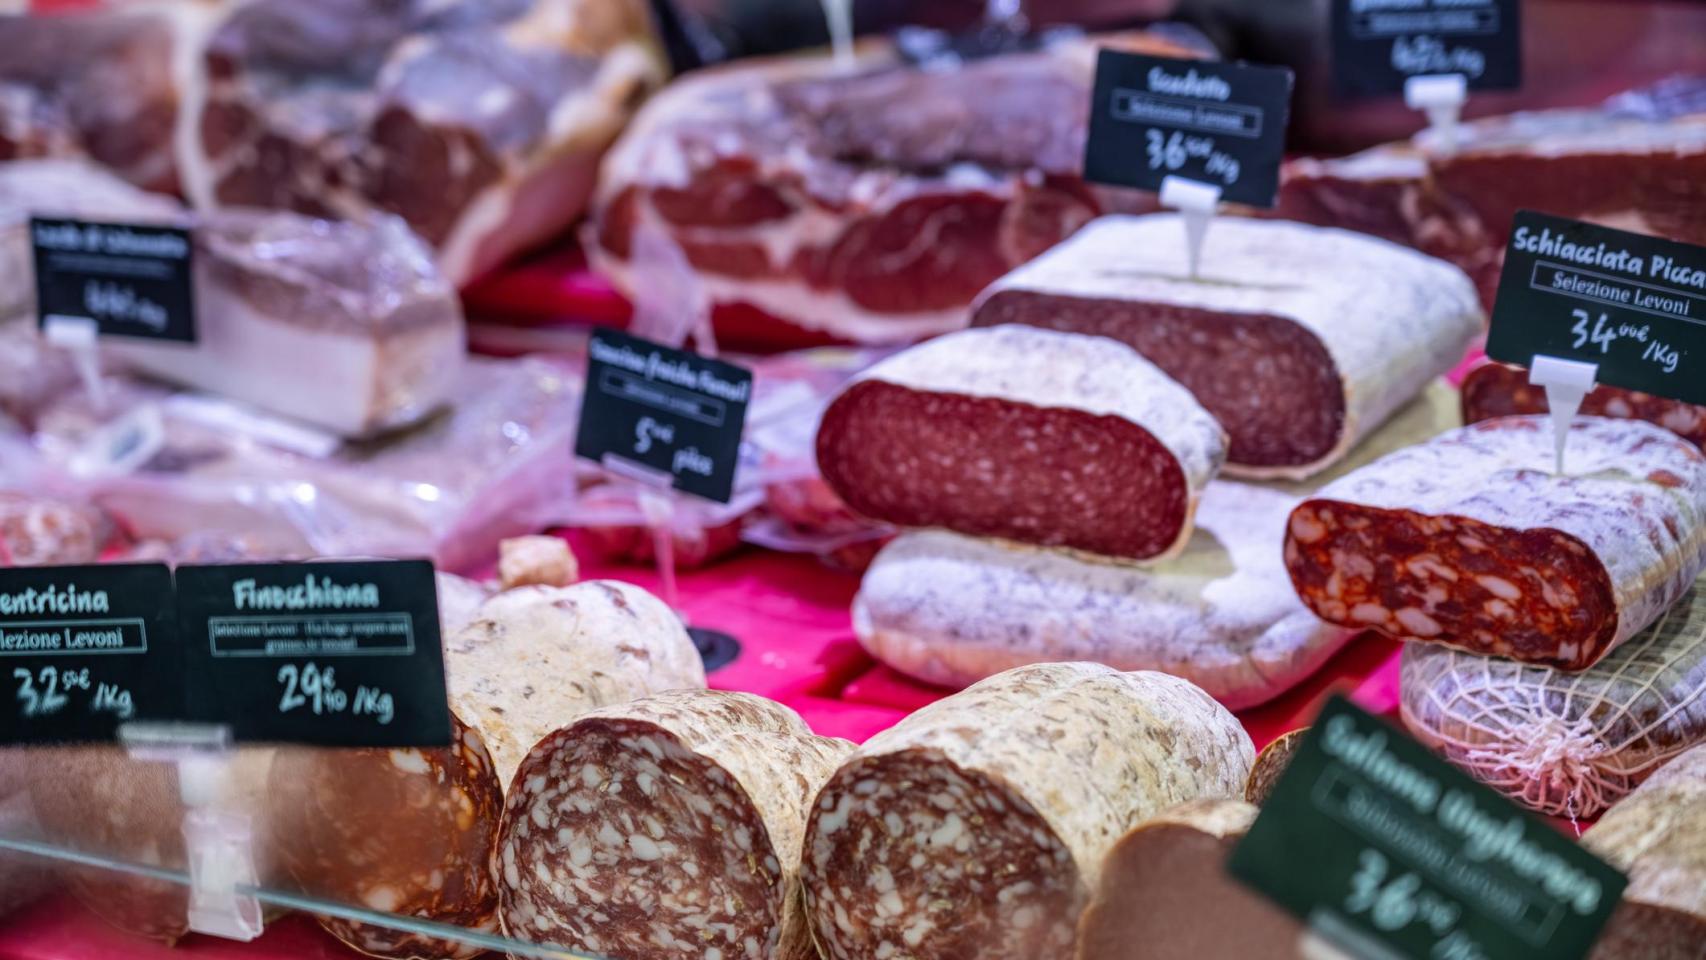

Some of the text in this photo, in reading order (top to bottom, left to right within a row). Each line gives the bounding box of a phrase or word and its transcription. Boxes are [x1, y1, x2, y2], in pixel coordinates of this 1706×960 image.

[1145, 128, 1187, 170] 36
[1513, 226, 1706, 288] Schiacciata Picca
[1553, 271, 1690, 316] Selezione Levoni
[1571, 308, 1617, 353] 34
[1642, 339, 1679, 373] /Kg
[0, 583, 109, 614] entricina
[233, 573, 380, 610] Finocchiona
[64, 627, 124, 648] Levoni
[13, 665, 69, 715] 32
[93, 681, 134, 718] /Kg
[277, 661, 323, 715] 29
[352, 685, 394, 725] /Kg
[1344, 847, 1421, 931] 36
